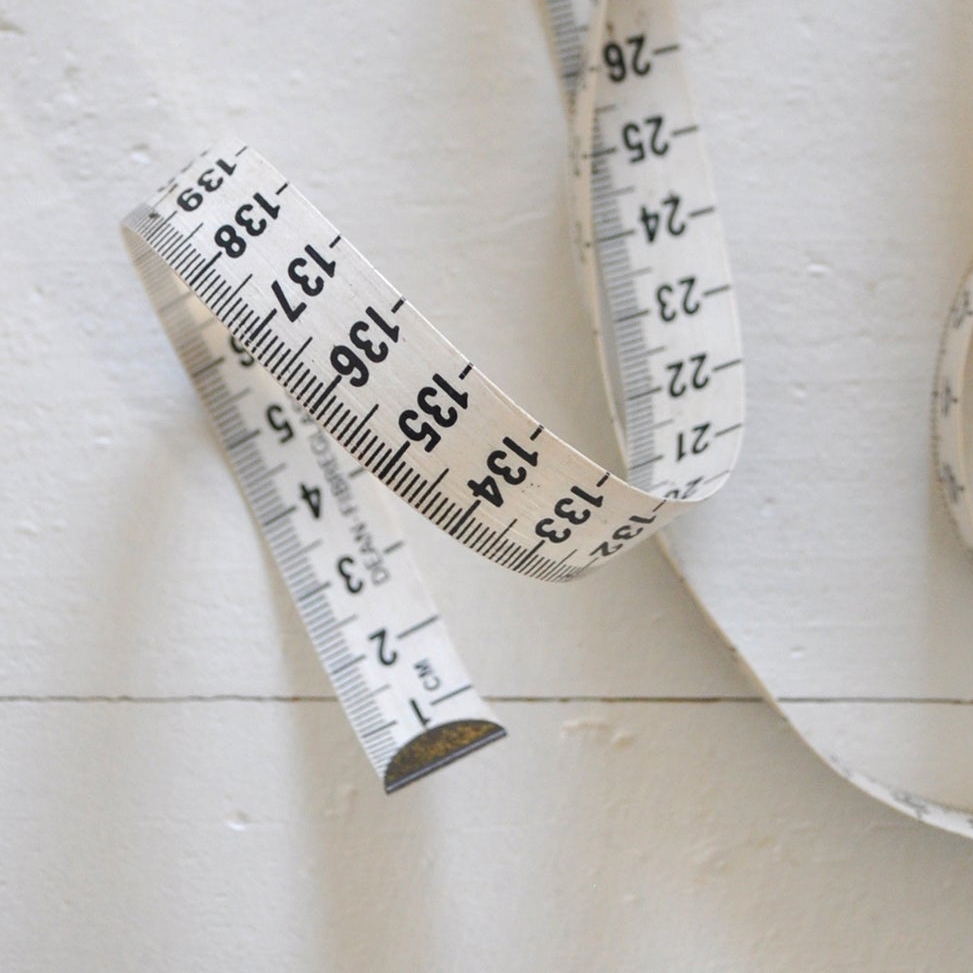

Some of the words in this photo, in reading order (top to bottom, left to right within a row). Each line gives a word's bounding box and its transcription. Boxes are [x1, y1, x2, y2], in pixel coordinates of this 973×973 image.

[604, 34, 651, 82] 26
[622, 116, 669, 163] 25
[176, 158, 237, 212] 139
[214, 192, 280, 259] 138
[640, 192, 686, 244] 24
[271, 244, 336, 323] 137
[656, 277, 701, 322] 23
[330, 306, 400, 387] 136
[665, 354, 710, 397] 22
[265, 404, 295, 444] 5
[398, 373, 469, 453] 135
[676, 422, 711, 462] 21
[467, 436, 539, 508] 134
[300, 483, 321, 520] 4
[535, 486, 604, 544] 133
[589, 514, 656, 558] 132
[338, 556, 363, 593] 3
[368, 629, 398, 666] 2
[410, 698, 430, 726] 1
